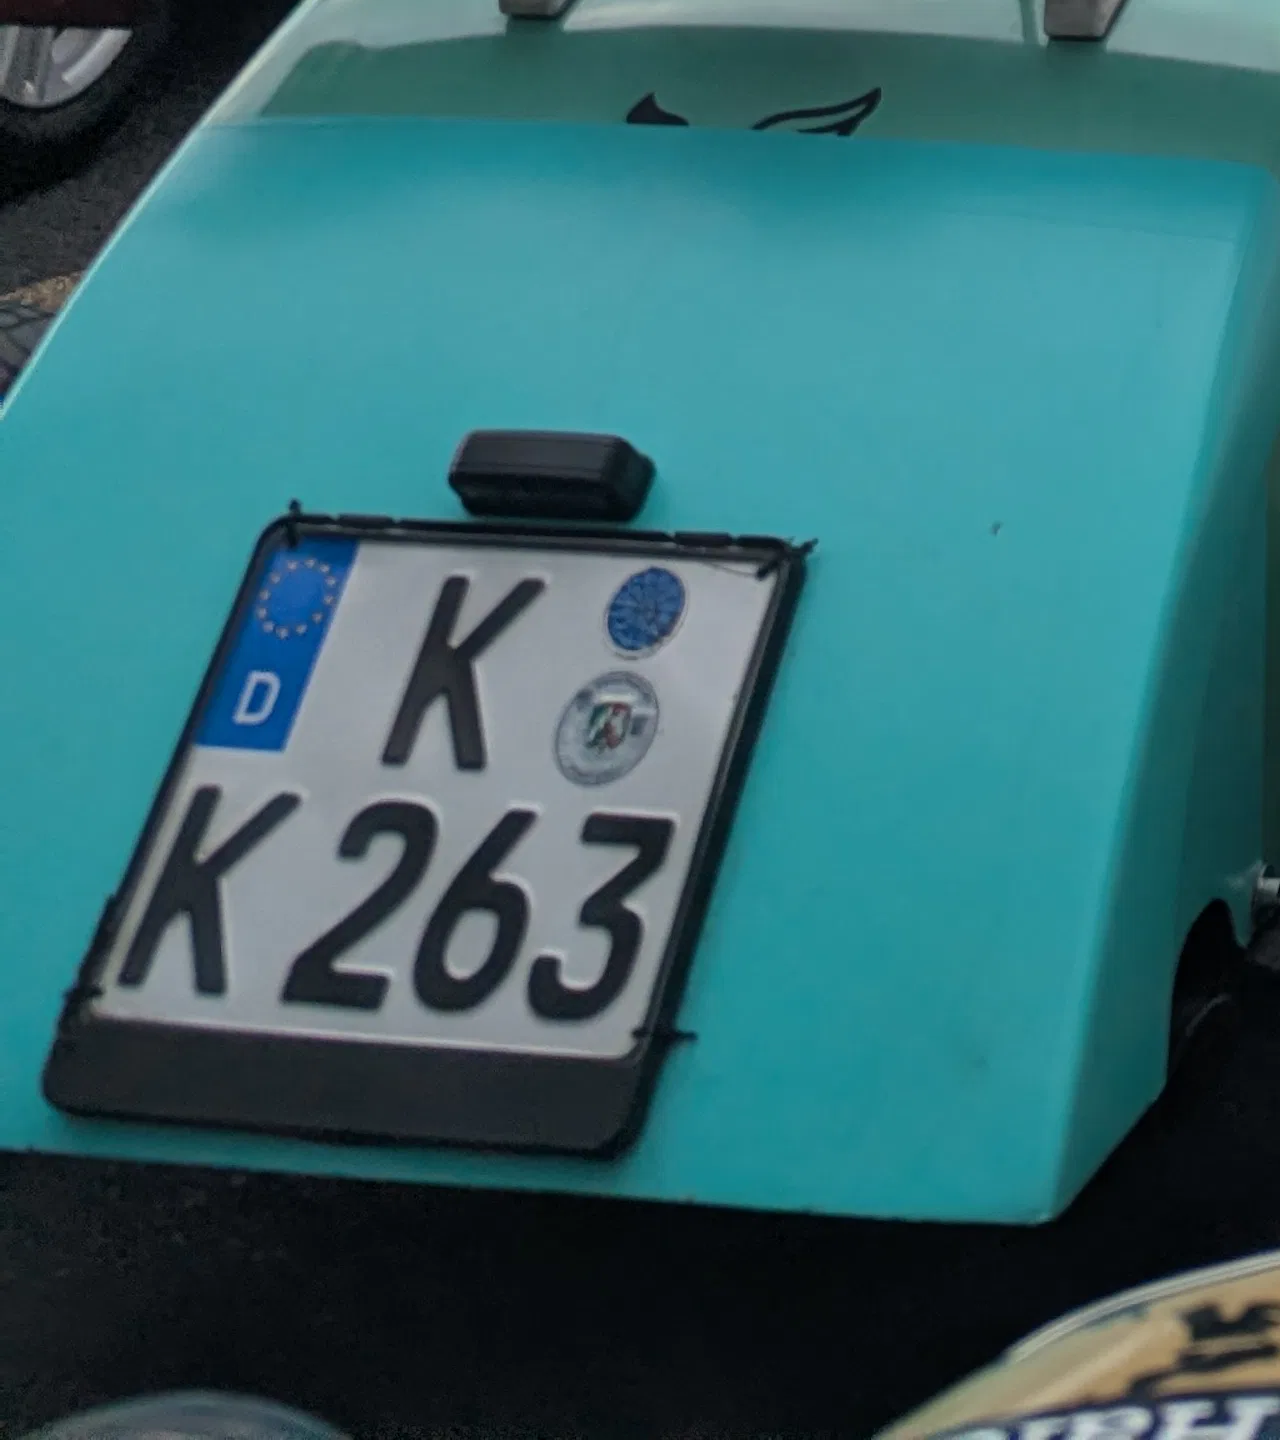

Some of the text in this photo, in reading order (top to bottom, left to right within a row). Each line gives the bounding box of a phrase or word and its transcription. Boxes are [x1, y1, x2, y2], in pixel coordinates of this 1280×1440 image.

[233, 671, 281, 726] D
[382, 574, 546, 772] K
[118, 783, 676, 1021] K 263
